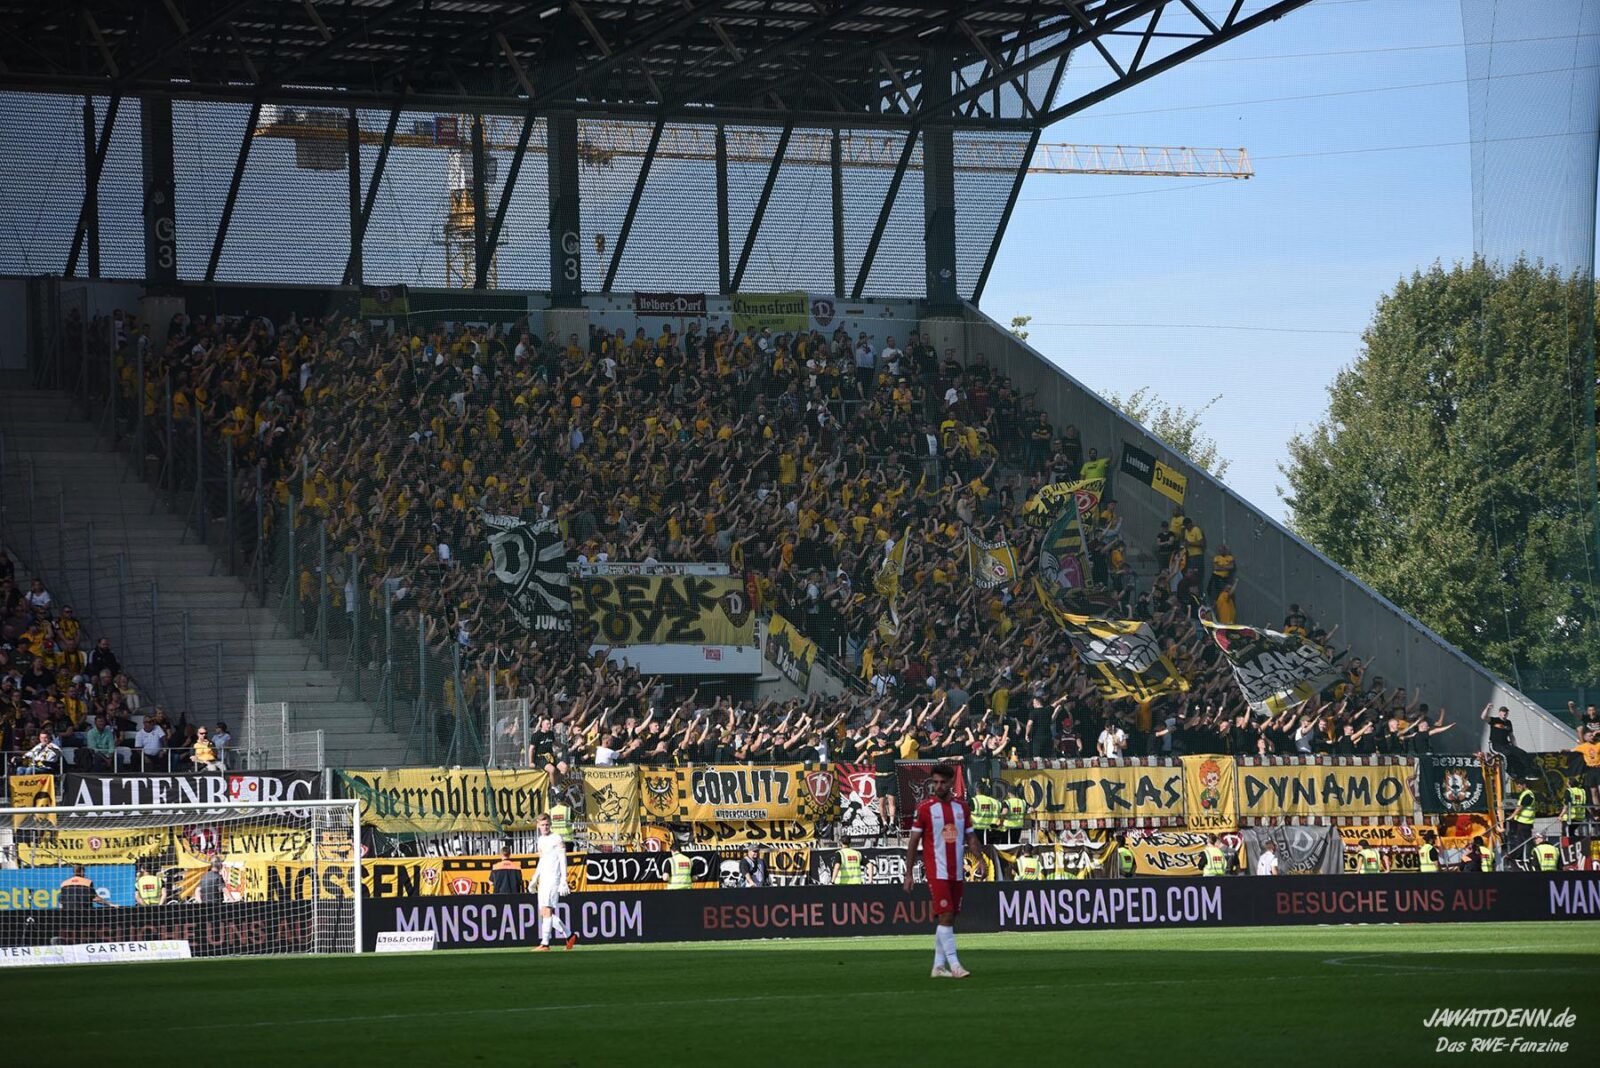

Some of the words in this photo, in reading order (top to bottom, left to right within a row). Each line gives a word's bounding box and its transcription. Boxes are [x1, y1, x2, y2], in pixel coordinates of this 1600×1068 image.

[159, 245, 173, 268] 3
[565, 258, 578, 280] 3
[70, 775, 313, 818] ALTENBRG
[691, 766, 790, 806] GÖRLITZ
[1244, 773, 1404, 808] DYNAMO
[1191, 816, 1233, 828] ULTRAS
[267, 864, 421, 901] NOSSEN
[703, 903, 825, 929] BESUCHE
[832, 902, 886, 927] UNS
[999, 885, 1223, 927] MANSCAPED.COM
[1276, 890, 1389, 914] BESUCHE
[1395, 889, 1445, 912] UNS
[1452, 888, 1499, 911] AUF
[396, 901, 643, 942] MANSCAPD.COM
